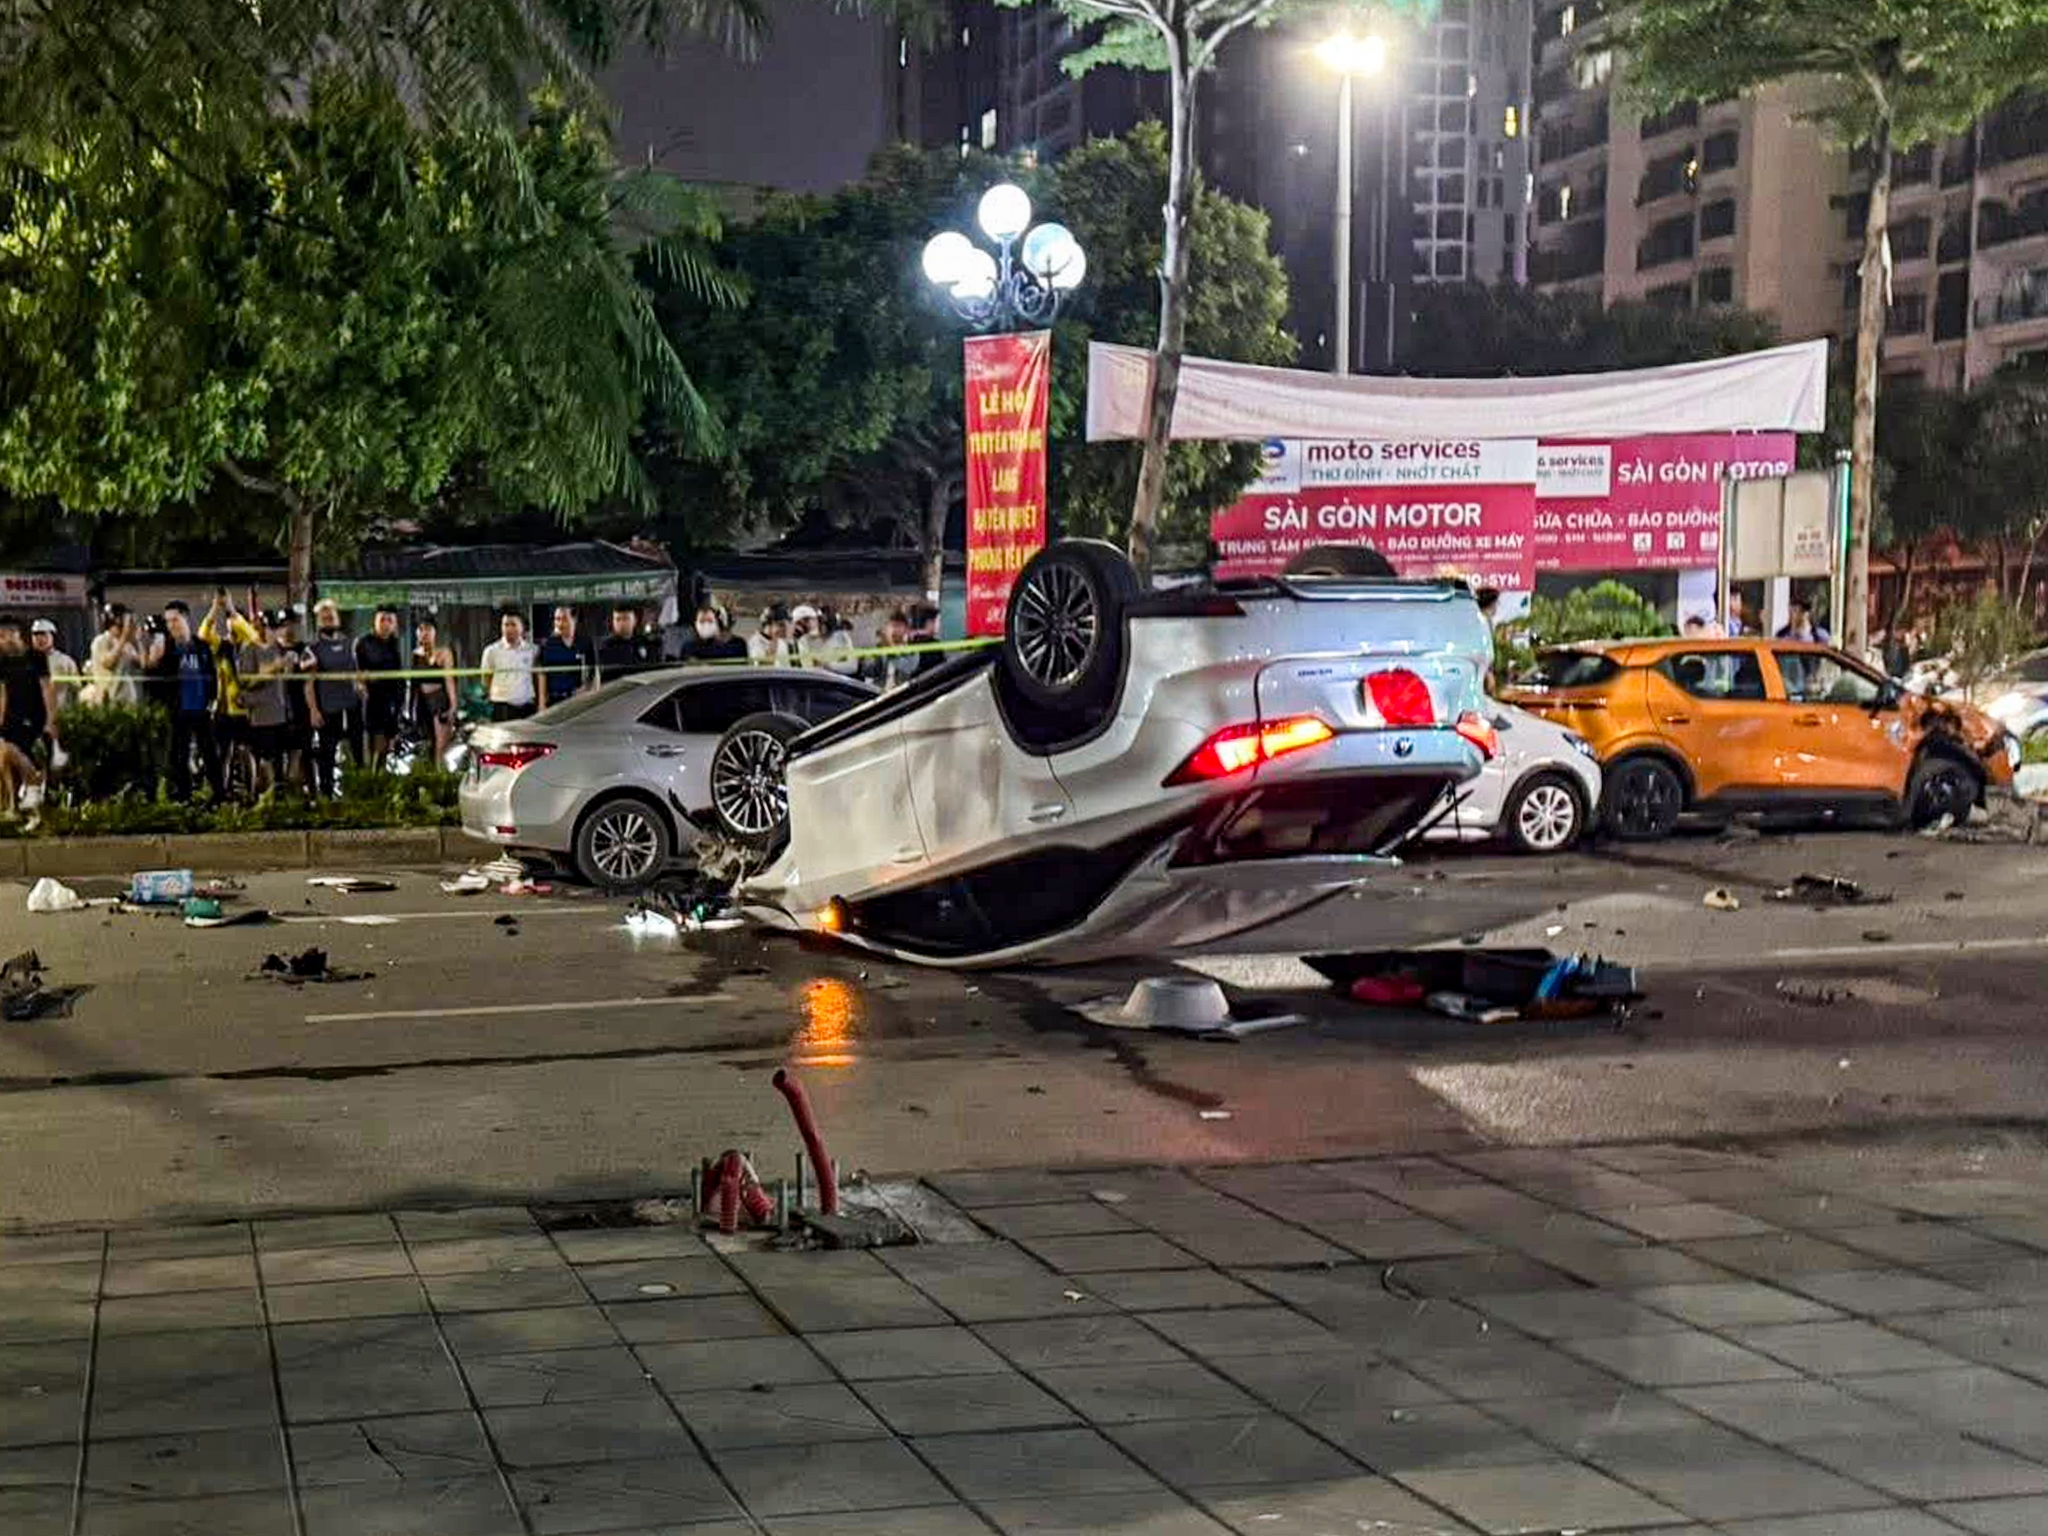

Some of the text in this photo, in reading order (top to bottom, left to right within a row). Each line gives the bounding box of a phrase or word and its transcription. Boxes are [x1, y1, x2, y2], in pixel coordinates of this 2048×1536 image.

[1308, 437, 1482, 462] moto services
[1617, 456, 1653, 484] SÀI
[1659, 454, 1708, 483] GÒN
[1263, 497, 1482, 531] SÀI GÒN MOTOR
[1566, 508, 1614, 530] CHỮA
[1219, 540, 1266, 554] TRUNG
[1495, 531, 1525, 549] MÁY
[1489, 571, 1520, 586] SYM
